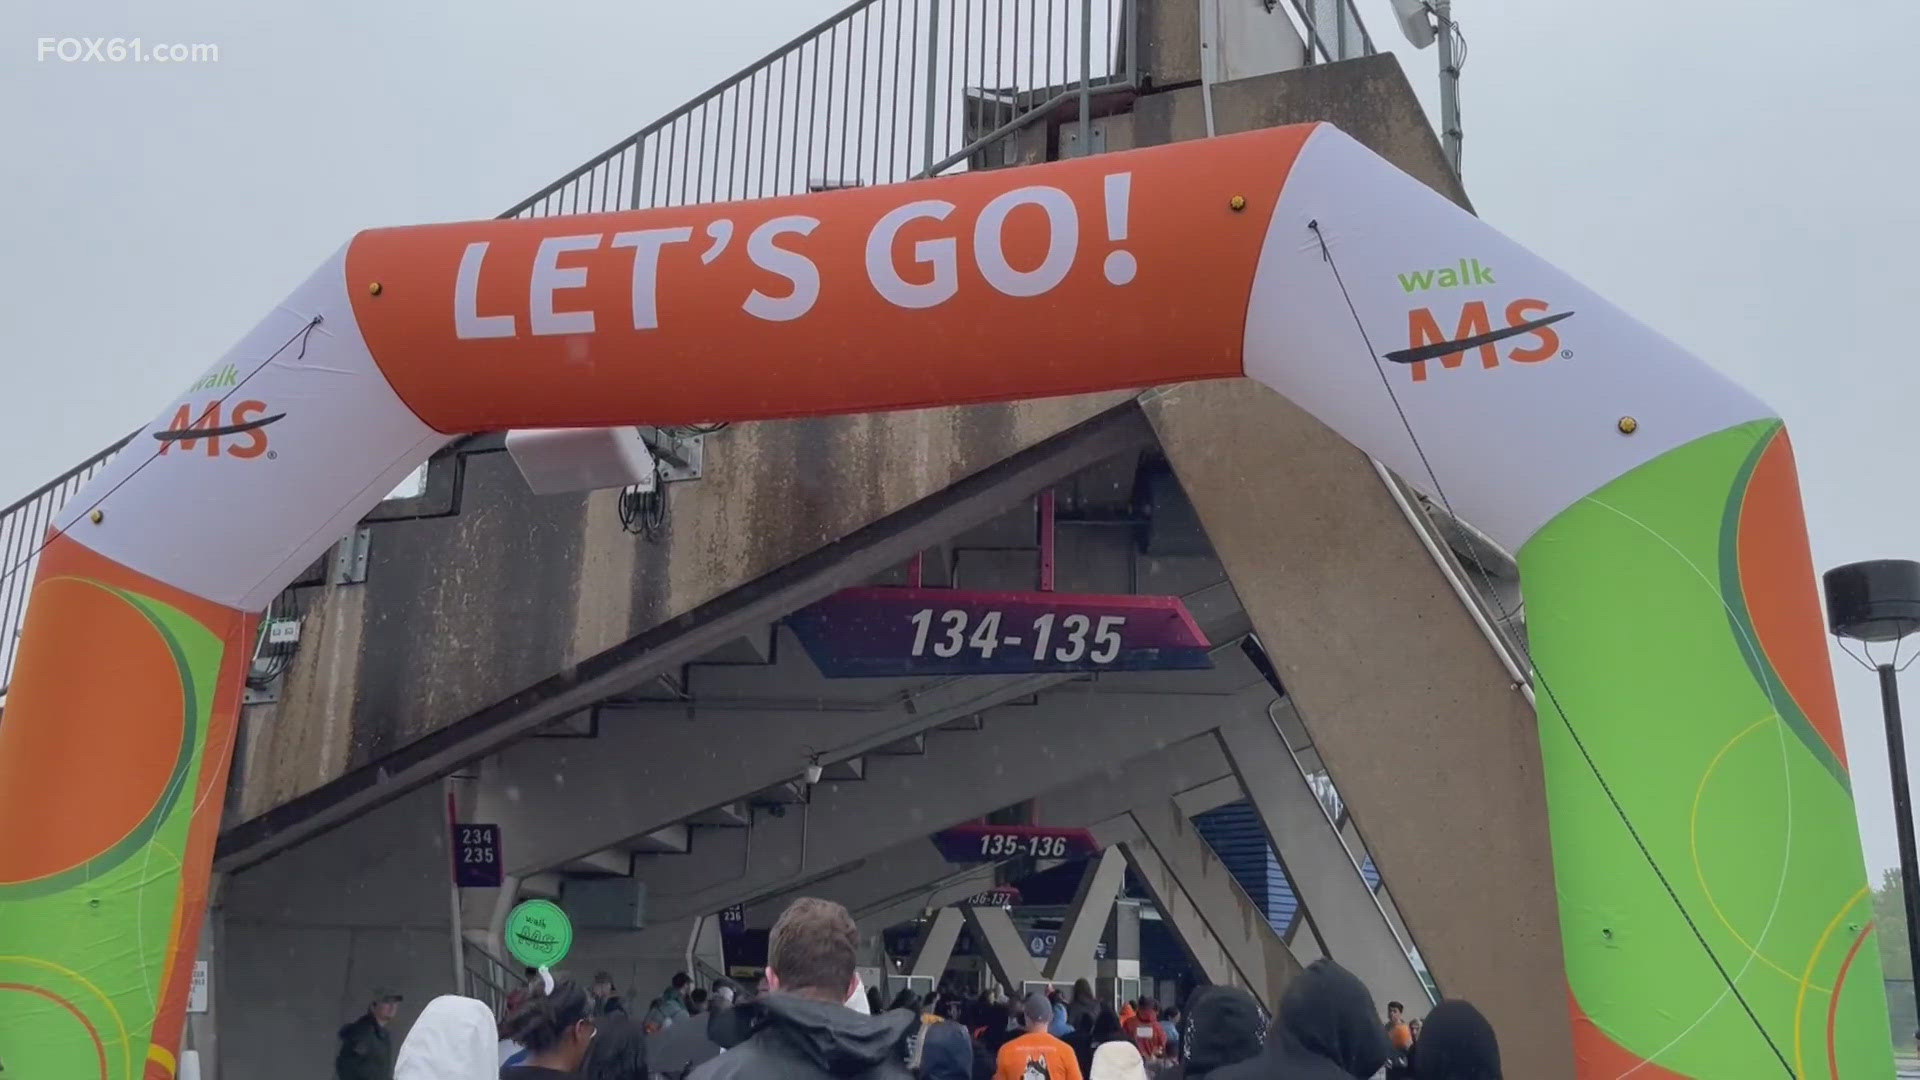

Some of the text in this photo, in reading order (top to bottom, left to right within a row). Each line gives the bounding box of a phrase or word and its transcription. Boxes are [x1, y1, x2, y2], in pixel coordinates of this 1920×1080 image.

[454, 171, 1138, 340] LET'S GO!
[1397, 258, 1496, 292] walk
[910, 608, 1126, 664] 134-135
[462, 828, 493, 844] 234
[980, 834, 1067, 857] 135-136
[464, 847, 494, 863] 235
